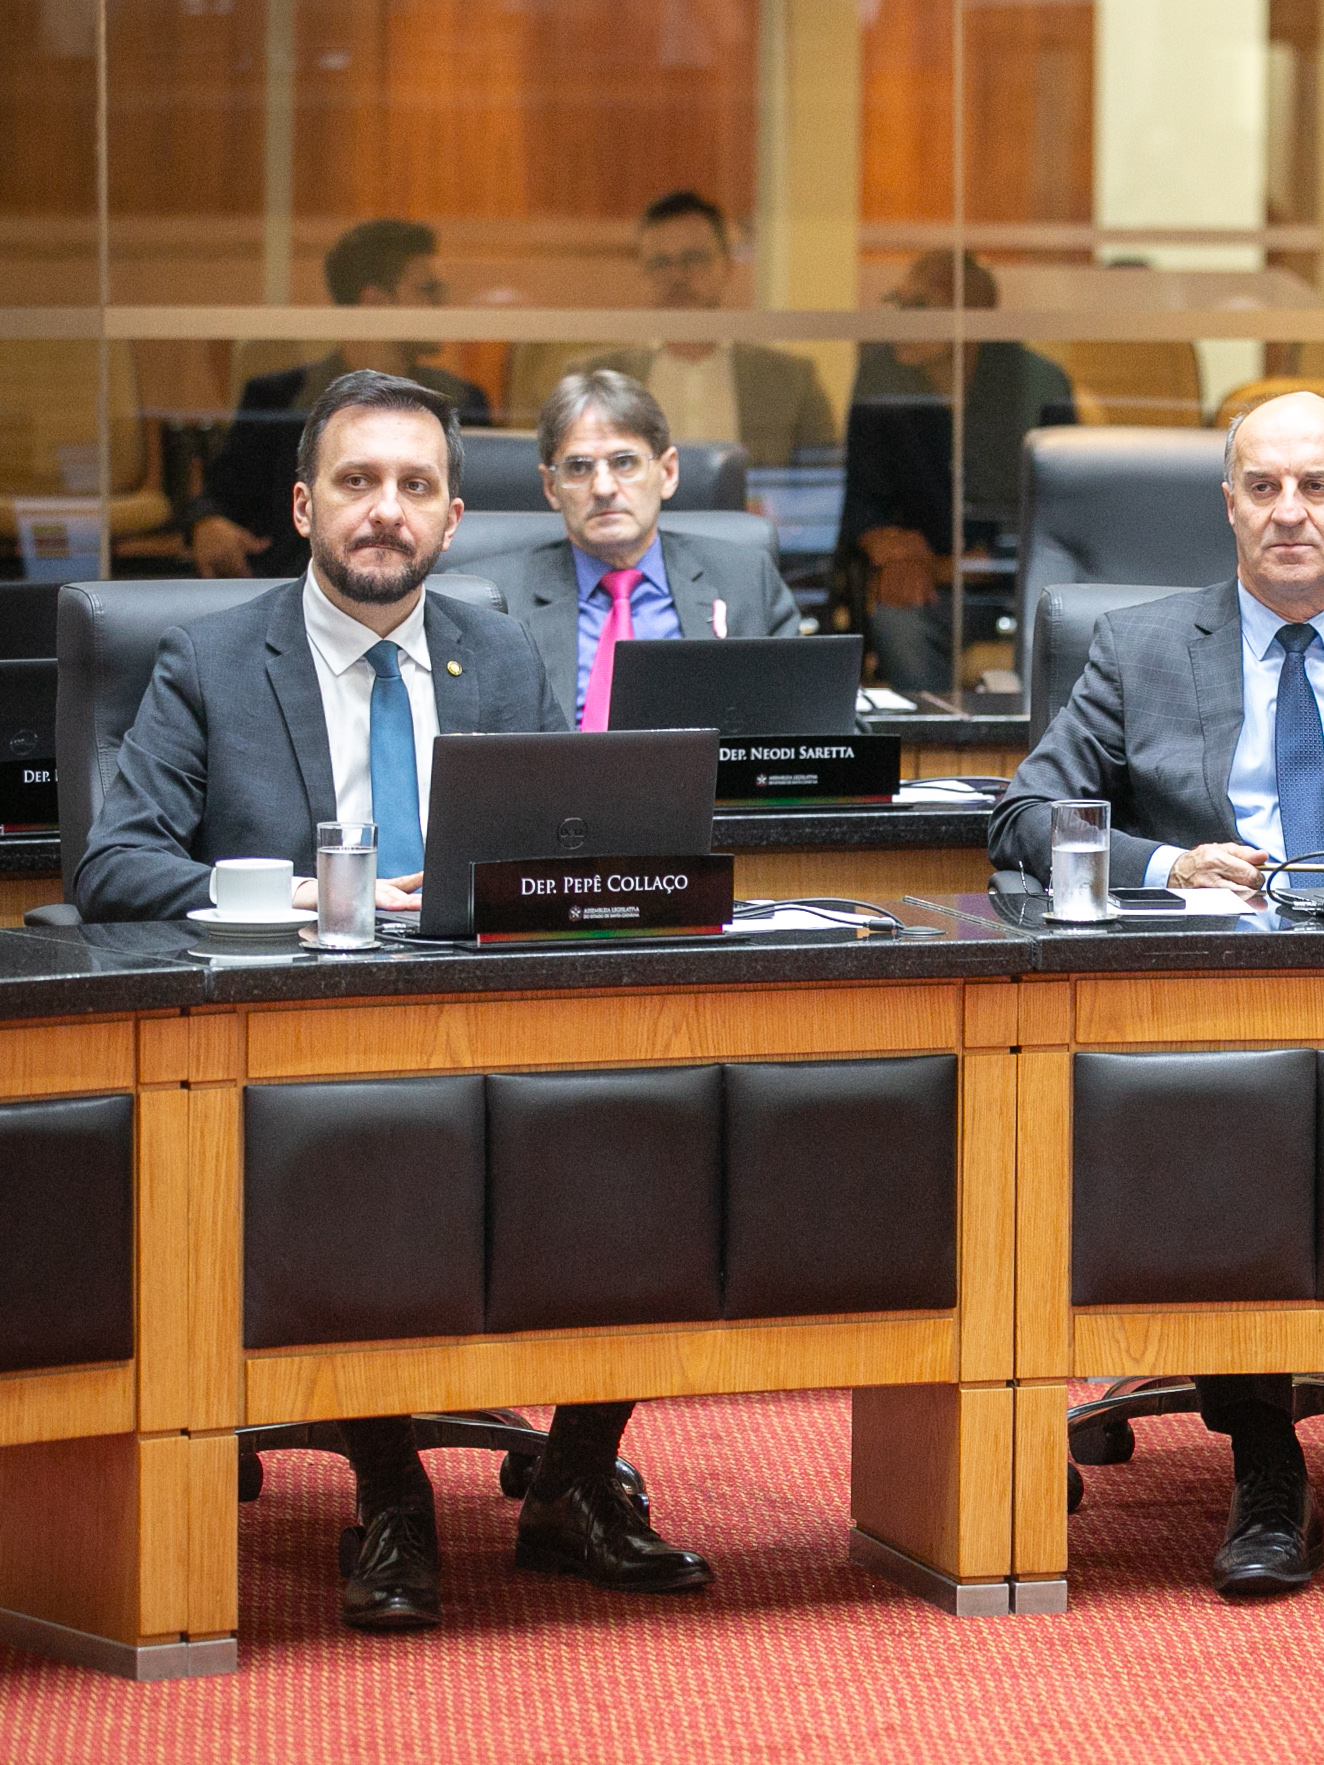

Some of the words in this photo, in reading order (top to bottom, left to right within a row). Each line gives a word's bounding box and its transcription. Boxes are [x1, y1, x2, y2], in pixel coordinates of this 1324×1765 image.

[719, 748, 747, 761] DEP.
[750, 747, 795, 760] NEODI
[799, 746, 855, 759] SARETTA
[24, 770, 51, 783] DEP.
[521, 878, 557, 895] DEP.
[564, 874, 602, 893] PEPÊ
[607, 875, 688, 894] COLLAÇO
